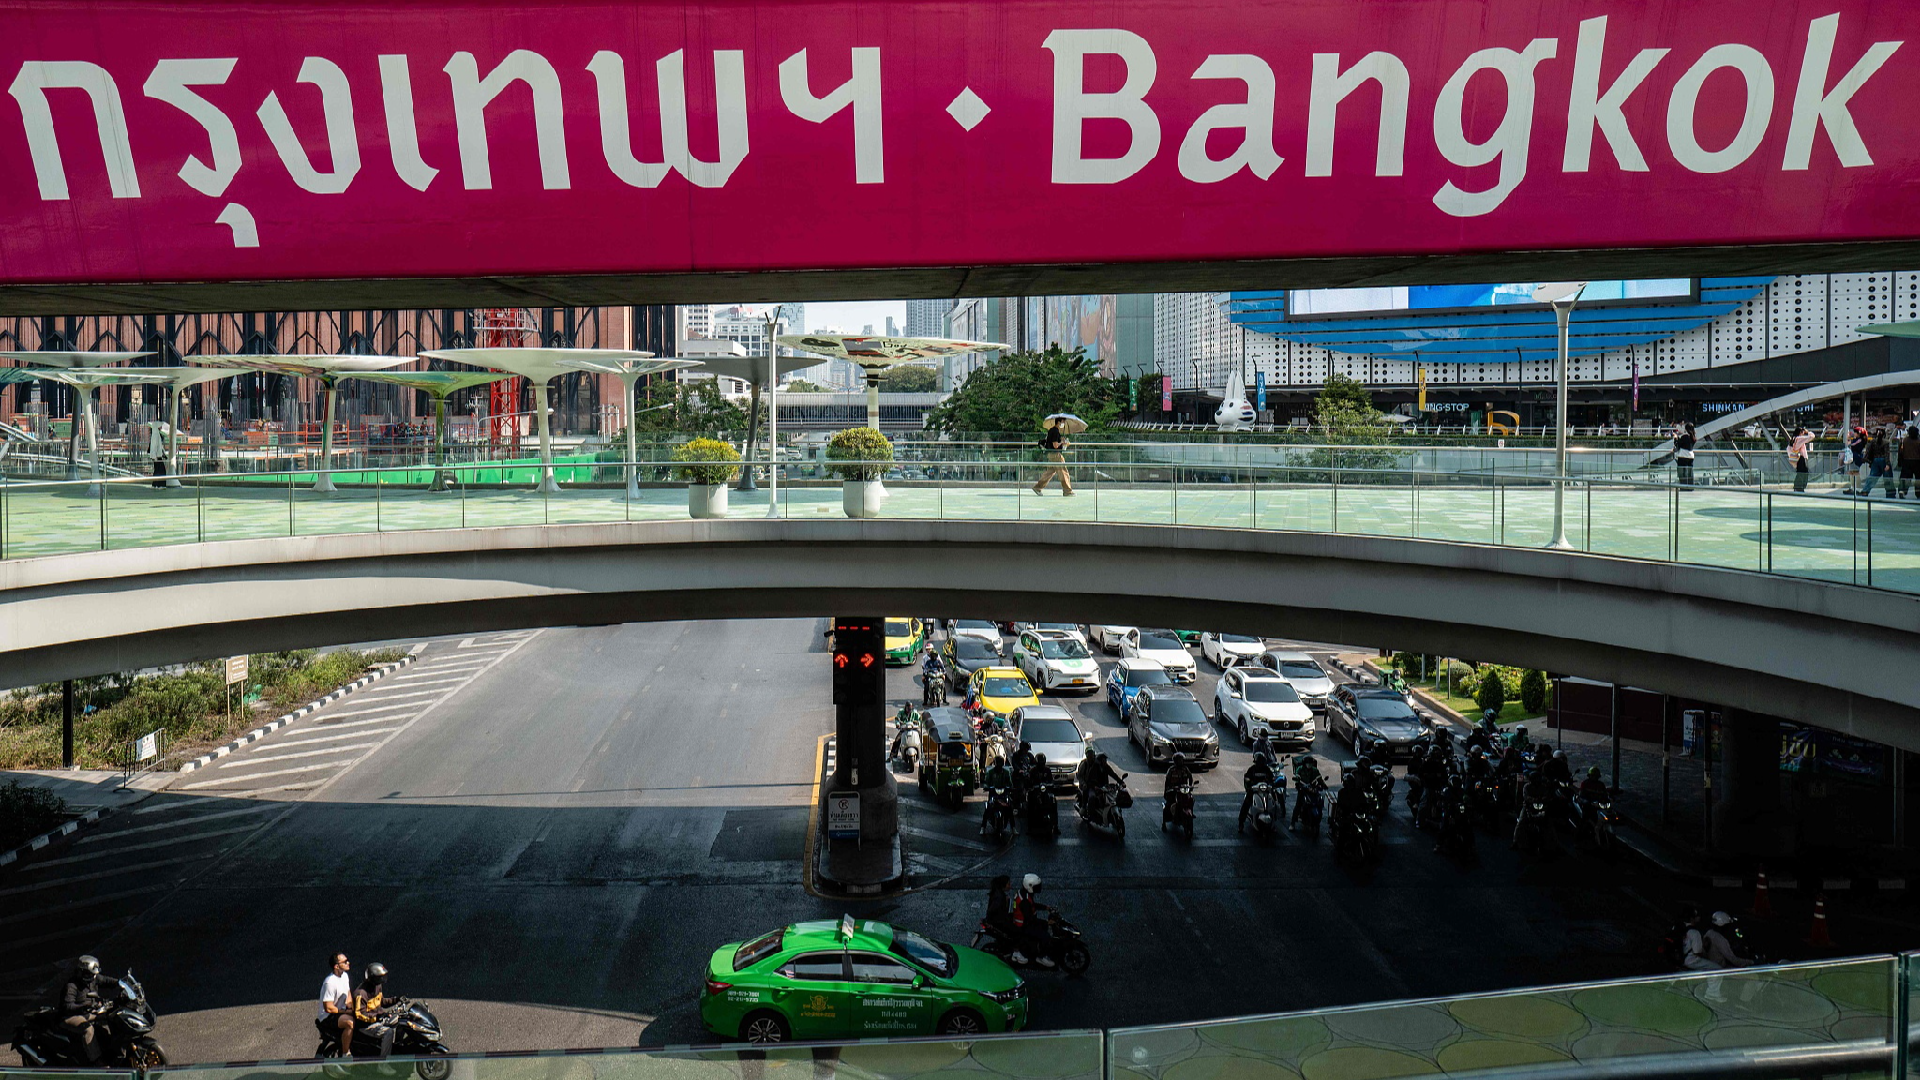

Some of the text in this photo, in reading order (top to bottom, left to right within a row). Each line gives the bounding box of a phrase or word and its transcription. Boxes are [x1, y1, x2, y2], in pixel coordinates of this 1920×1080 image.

[8, 11, 1904, 247] กรุงเทพฯ Bangkok
